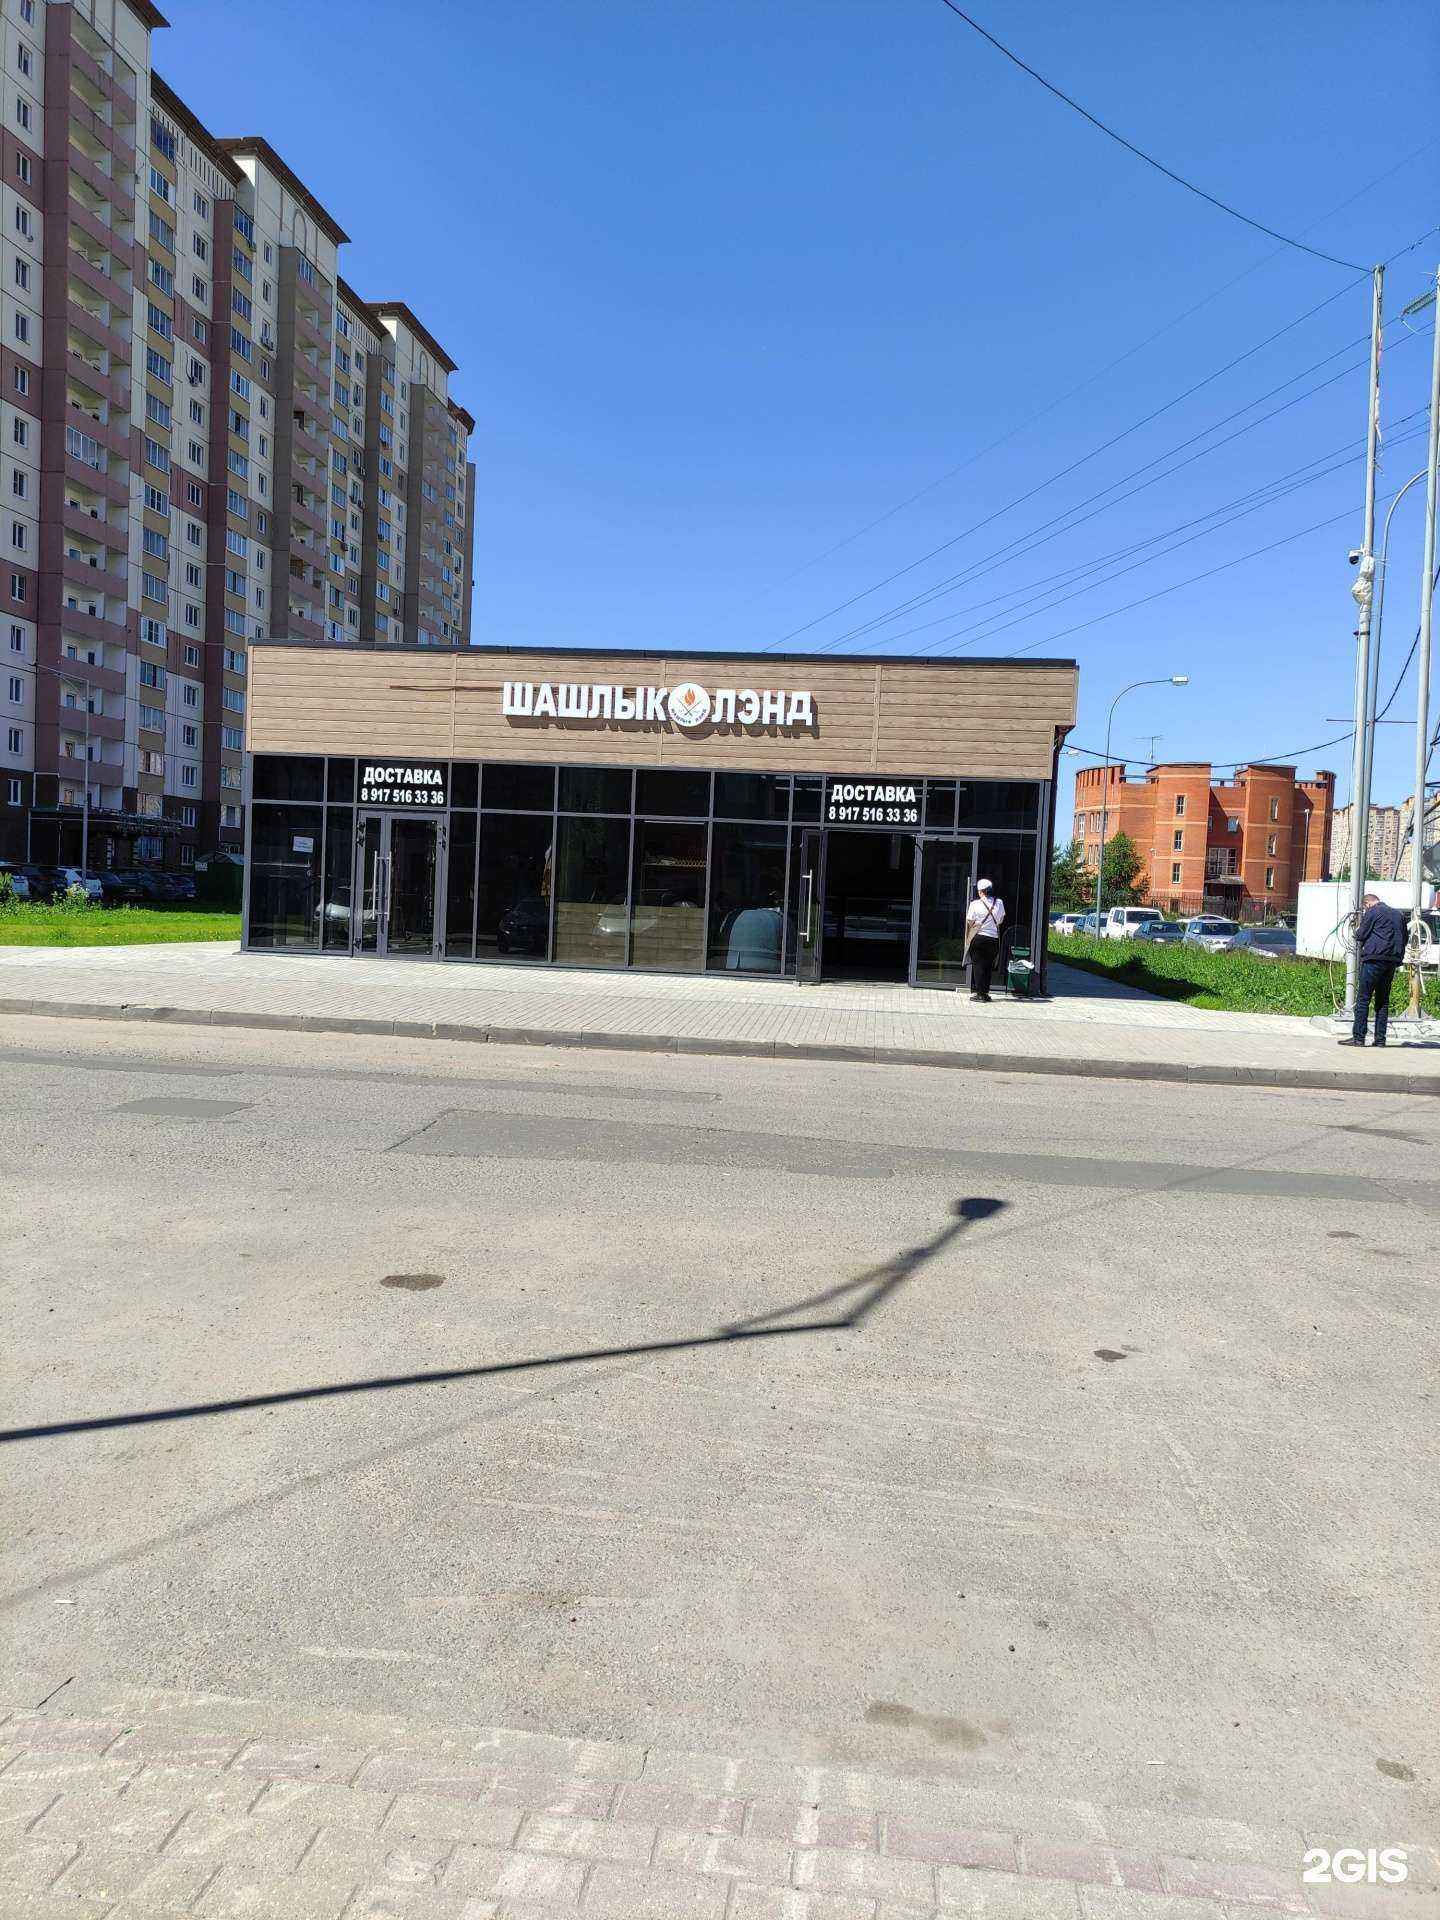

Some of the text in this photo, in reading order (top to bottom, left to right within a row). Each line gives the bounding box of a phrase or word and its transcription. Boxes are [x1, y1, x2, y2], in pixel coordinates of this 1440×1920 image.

[502, 682, 668, 722] ШАШЛЫК
[711, 688, 813, 726] ЛЭНД
[363, 766, 443, 785] ДОСТАВКА
[361, 787, 444, 805] 8 917 516 33 36
[831, 784, 917, 803] ДОСТАВКА
[828, 805, 918, 823] 8 917 516 33 36
